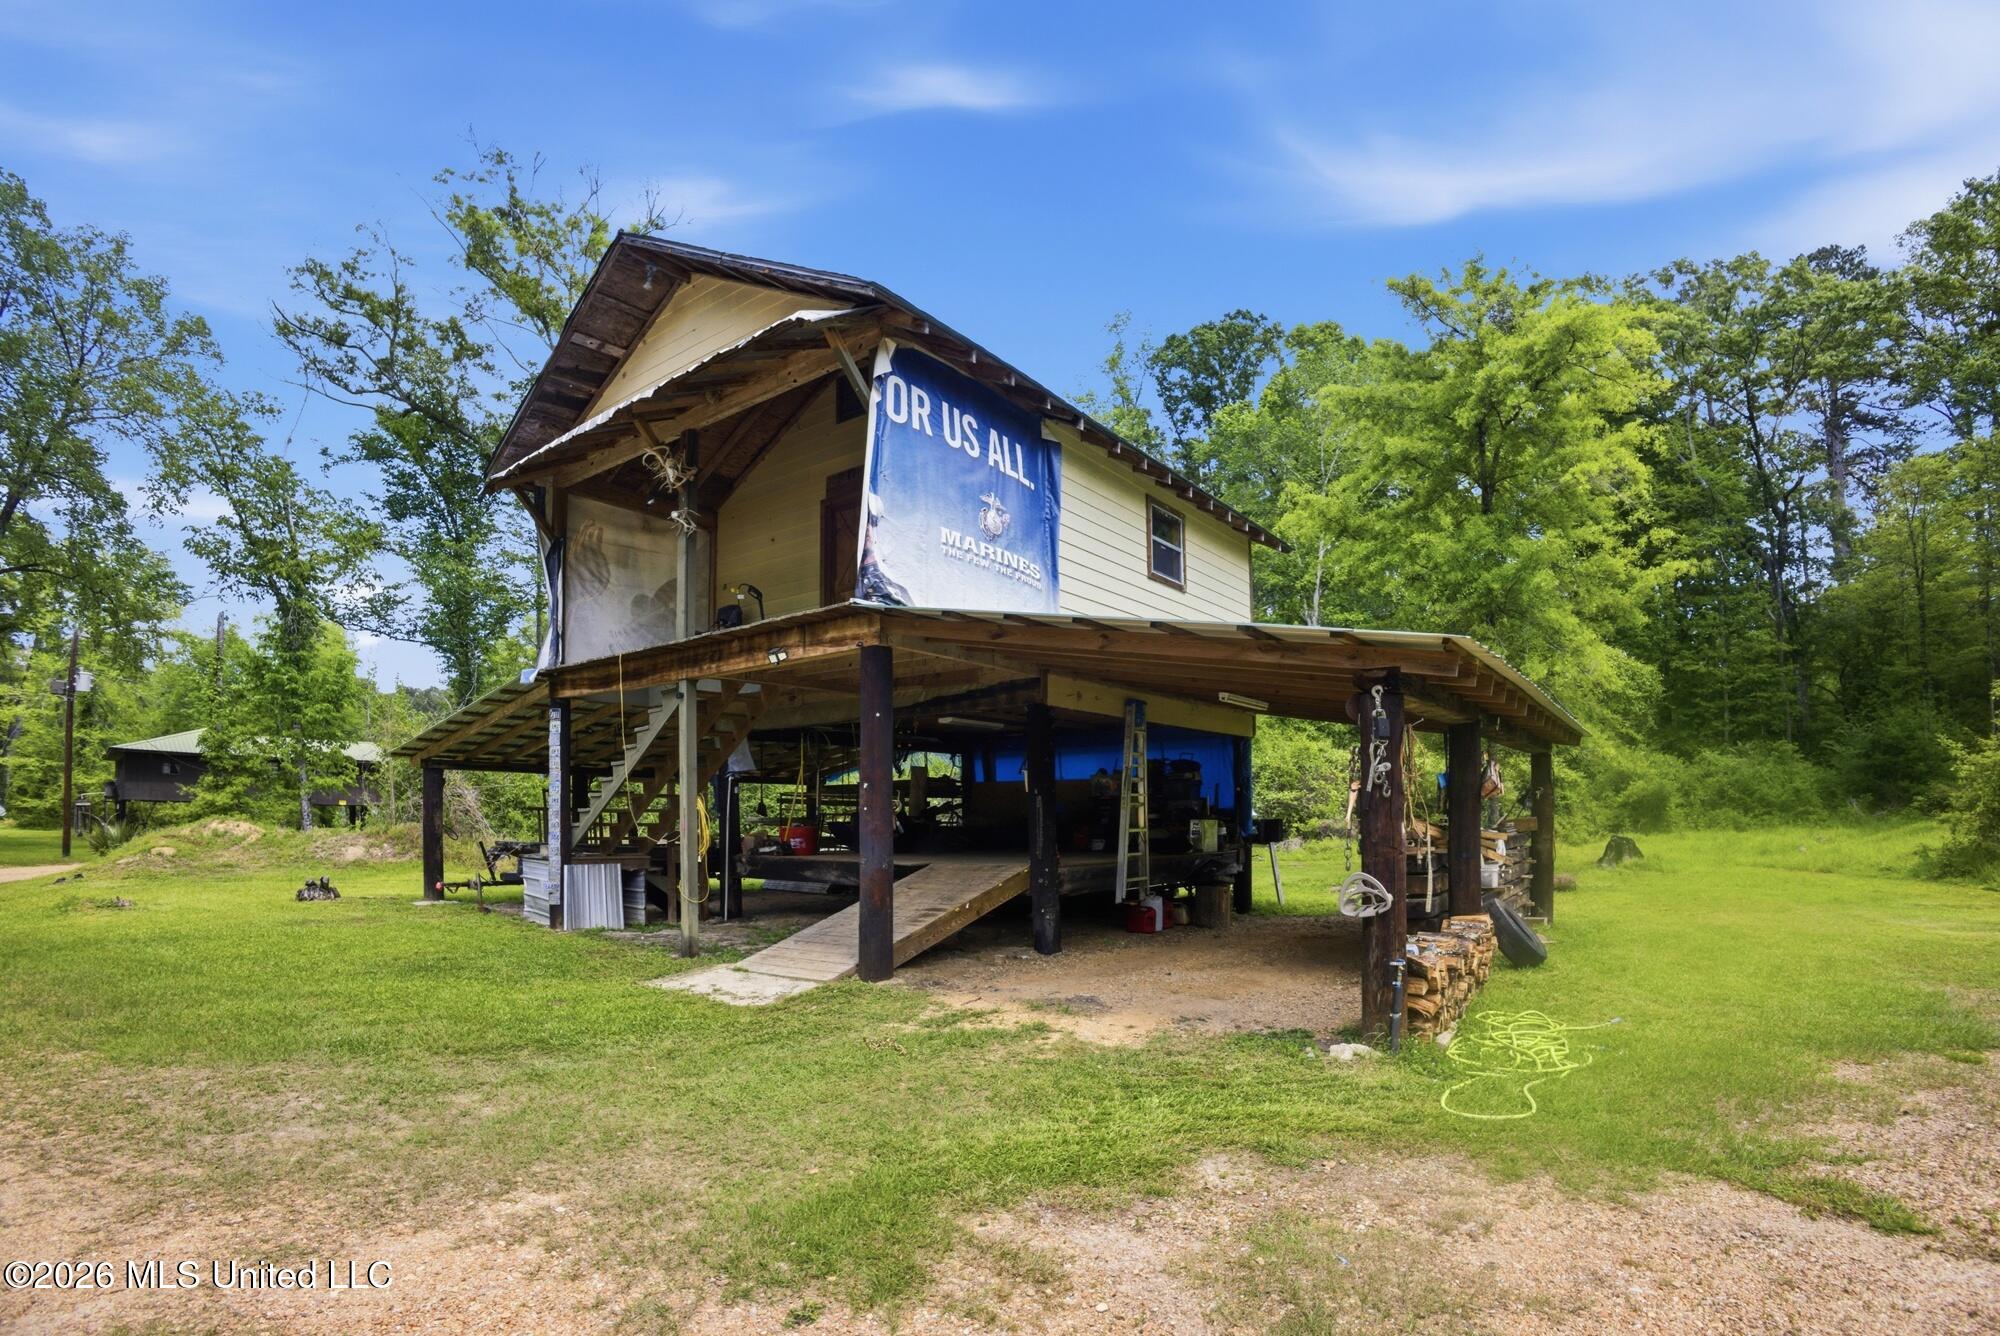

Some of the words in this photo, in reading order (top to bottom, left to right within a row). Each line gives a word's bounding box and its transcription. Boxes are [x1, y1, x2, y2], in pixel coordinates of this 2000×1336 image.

[941, 400, 981, 458] US
[987, 428, 1036, 491] ALL.
[939, 526, 1041, 580] MARINES
[942, 545, 963, 560] THE
[993, 563, 1013, 577] THE
